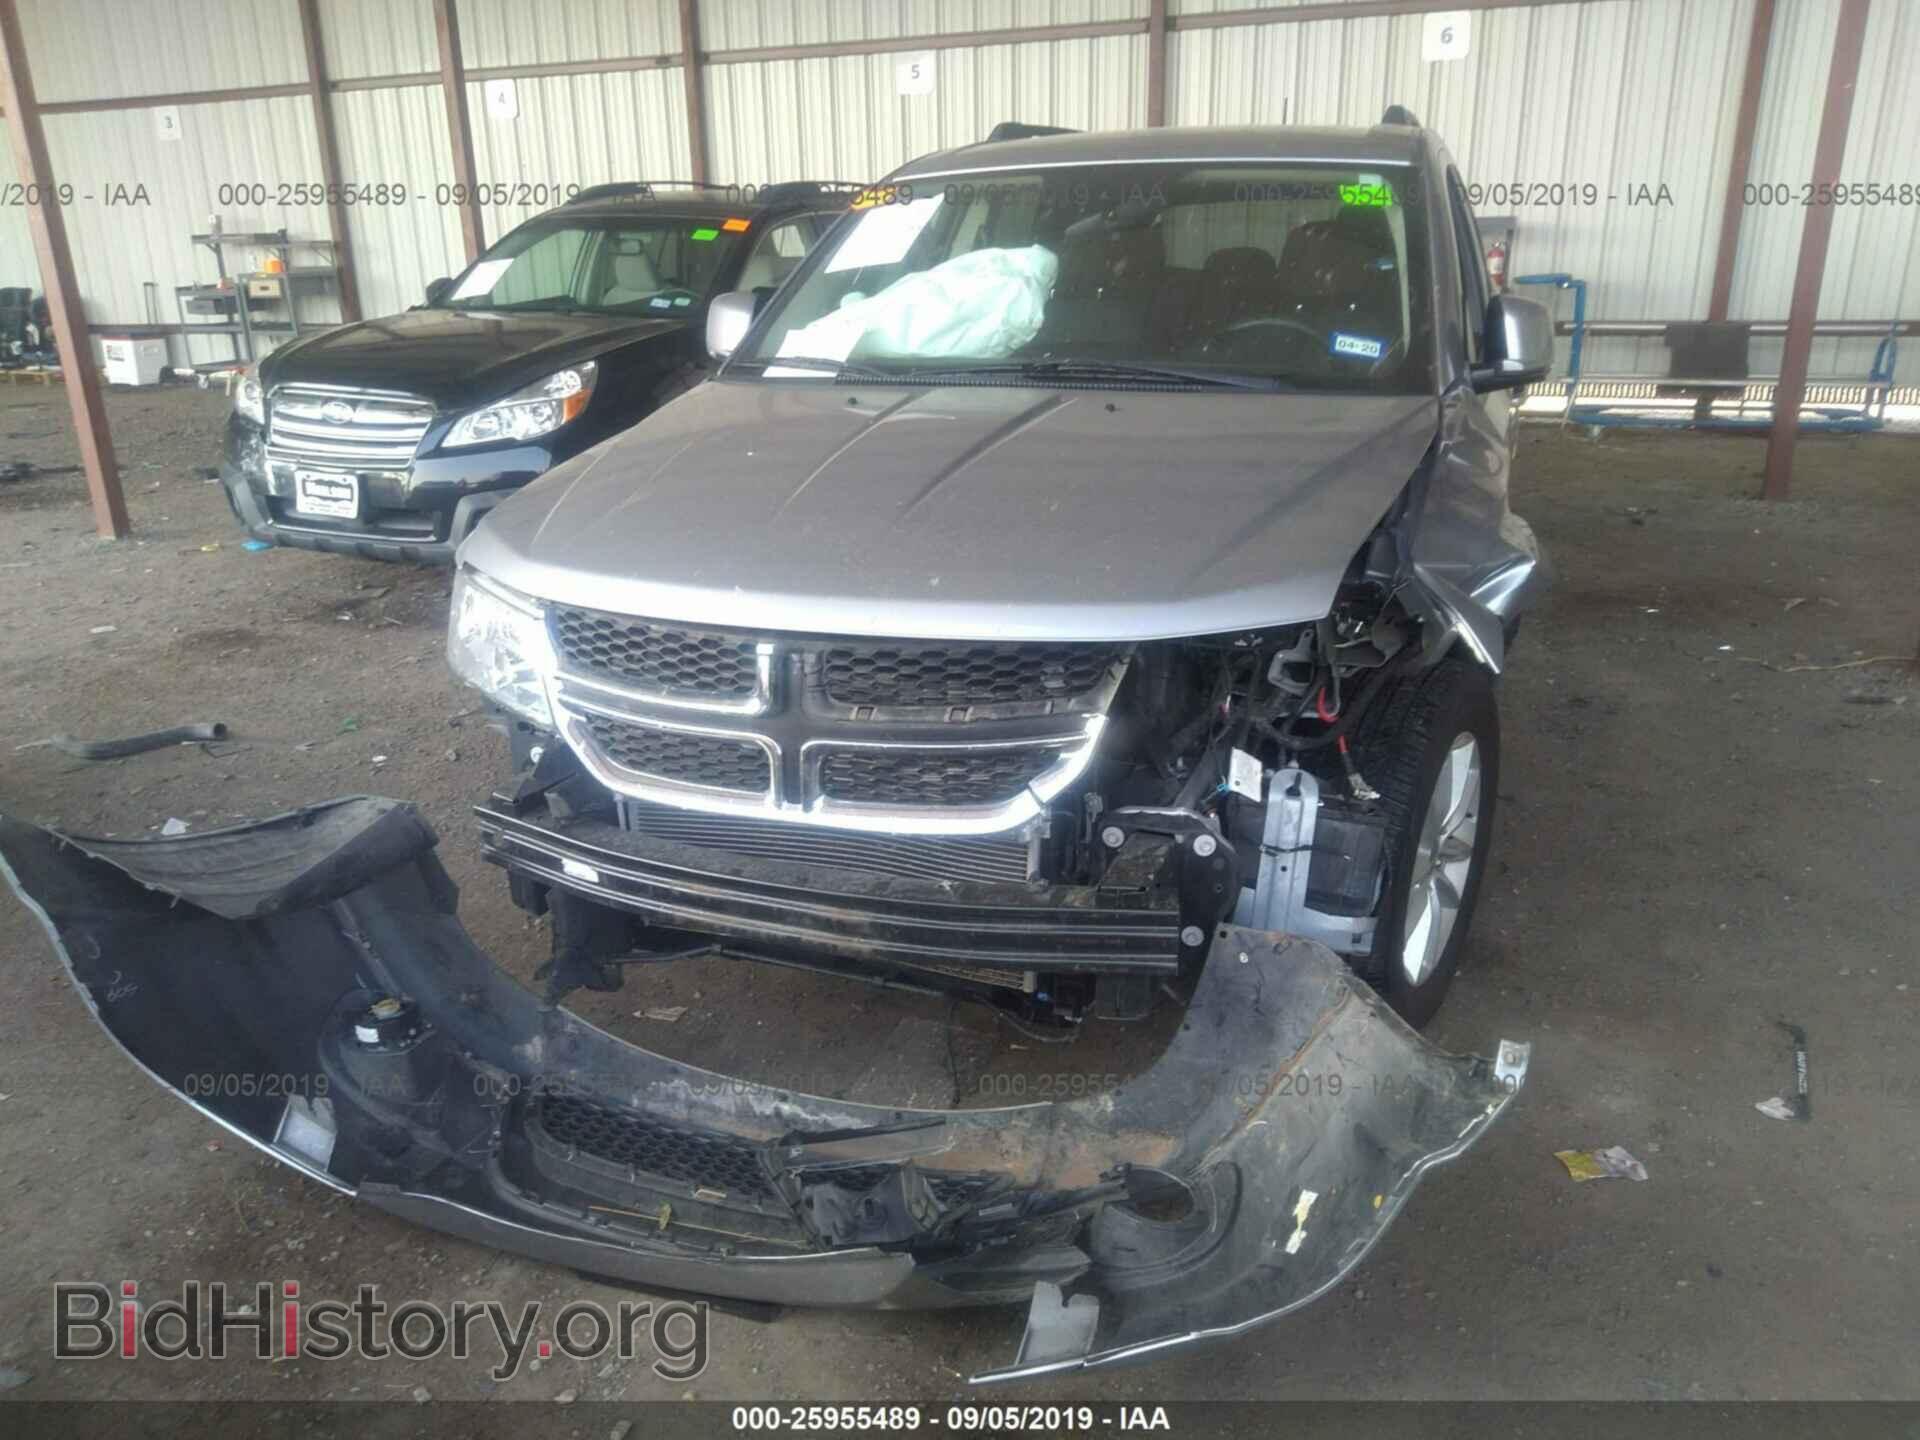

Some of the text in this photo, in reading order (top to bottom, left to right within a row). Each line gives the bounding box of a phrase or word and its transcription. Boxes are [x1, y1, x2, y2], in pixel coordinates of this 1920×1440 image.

[1440, 26, 1453, 44] 6
[911, 64, 921, 80] 5
[164, 115, 173, 129] 3
